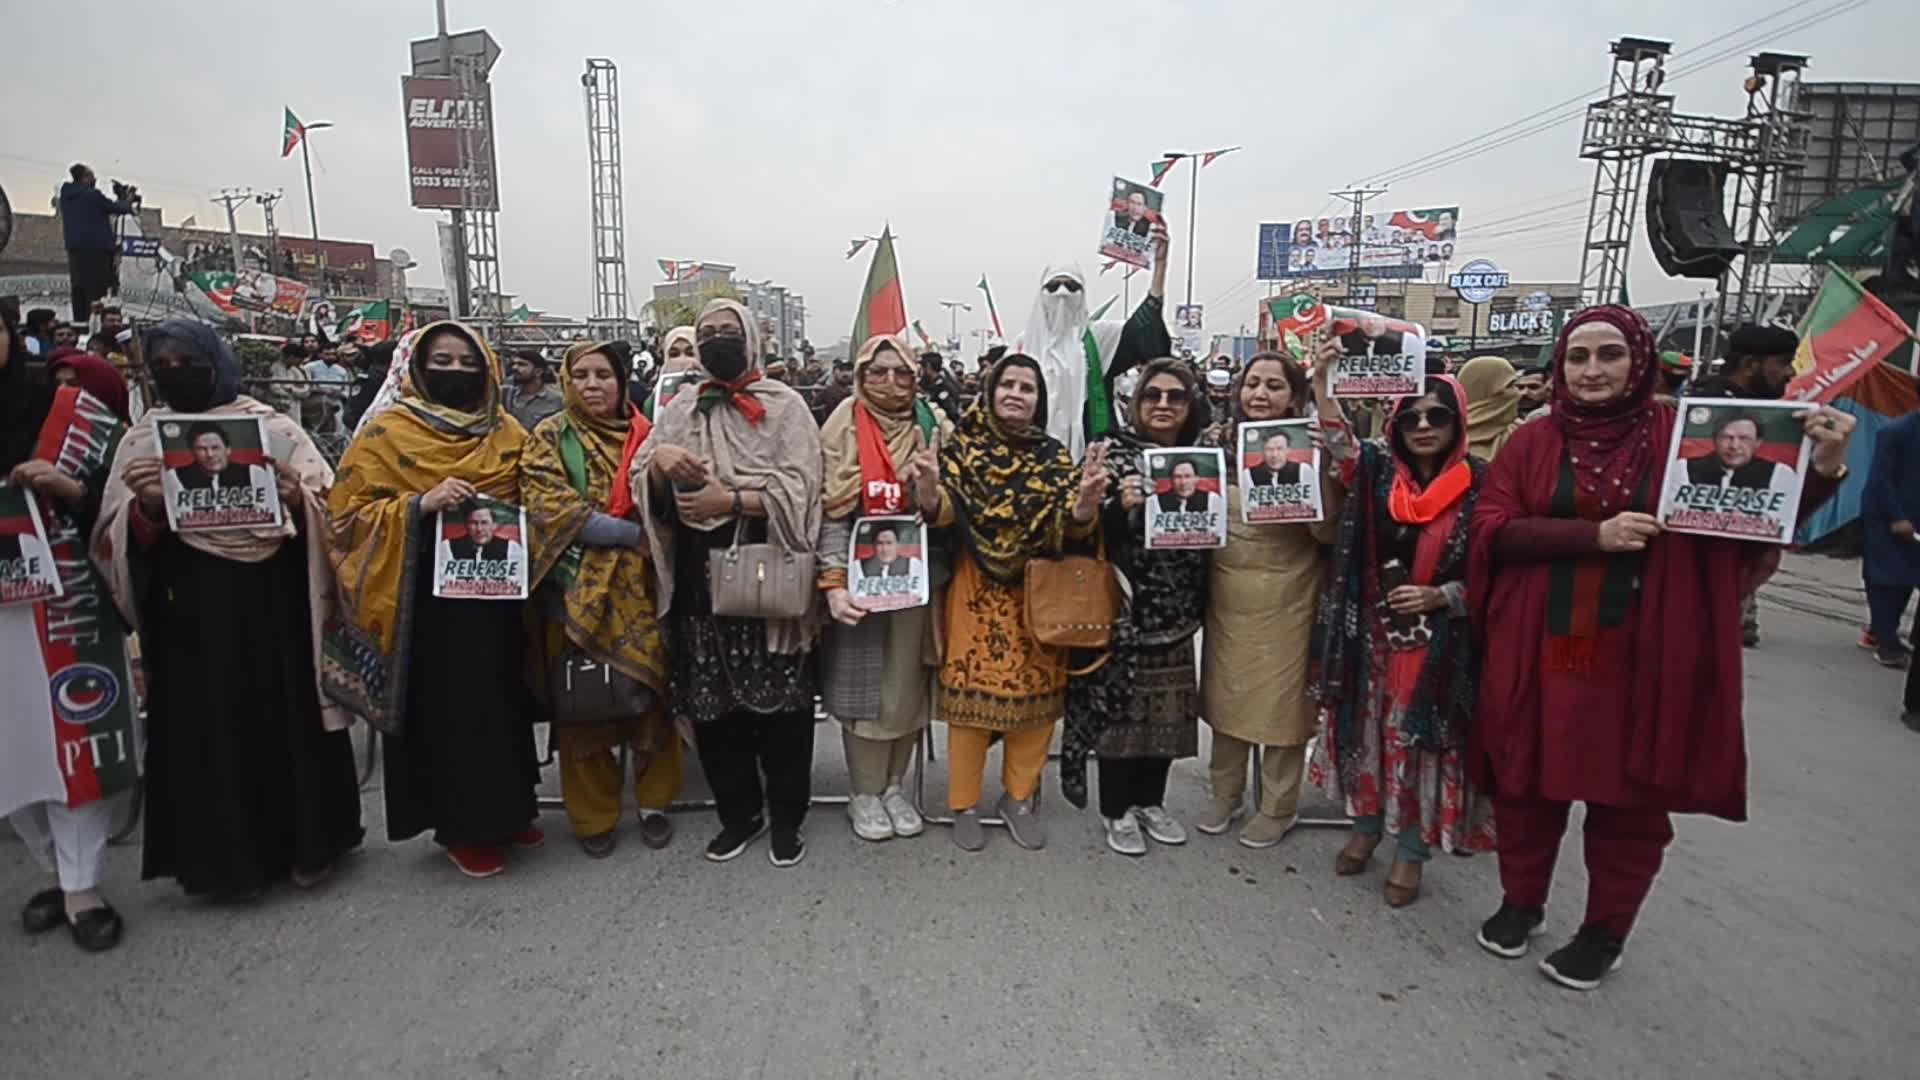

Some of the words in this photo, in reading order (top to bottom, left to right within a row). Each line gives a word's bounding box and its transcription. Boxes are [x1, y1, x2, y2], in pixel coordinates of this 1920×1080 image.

[1451, 274, 1482, 287] BLACK
[1489, 312, 1539, 331] BLACK
[1337, 355, 1415, 372] RELEASE
[177, 487, 265, 507] RELEASE
[1249, 484, 1311, 502] RELEASE
[1674, 484, 1785, 511] RELEASE
[1154, 512, 1218, 528] RELEASE
[445, 561, 519, 576] RELEASE
[64, 730, 126, 776] PTI
